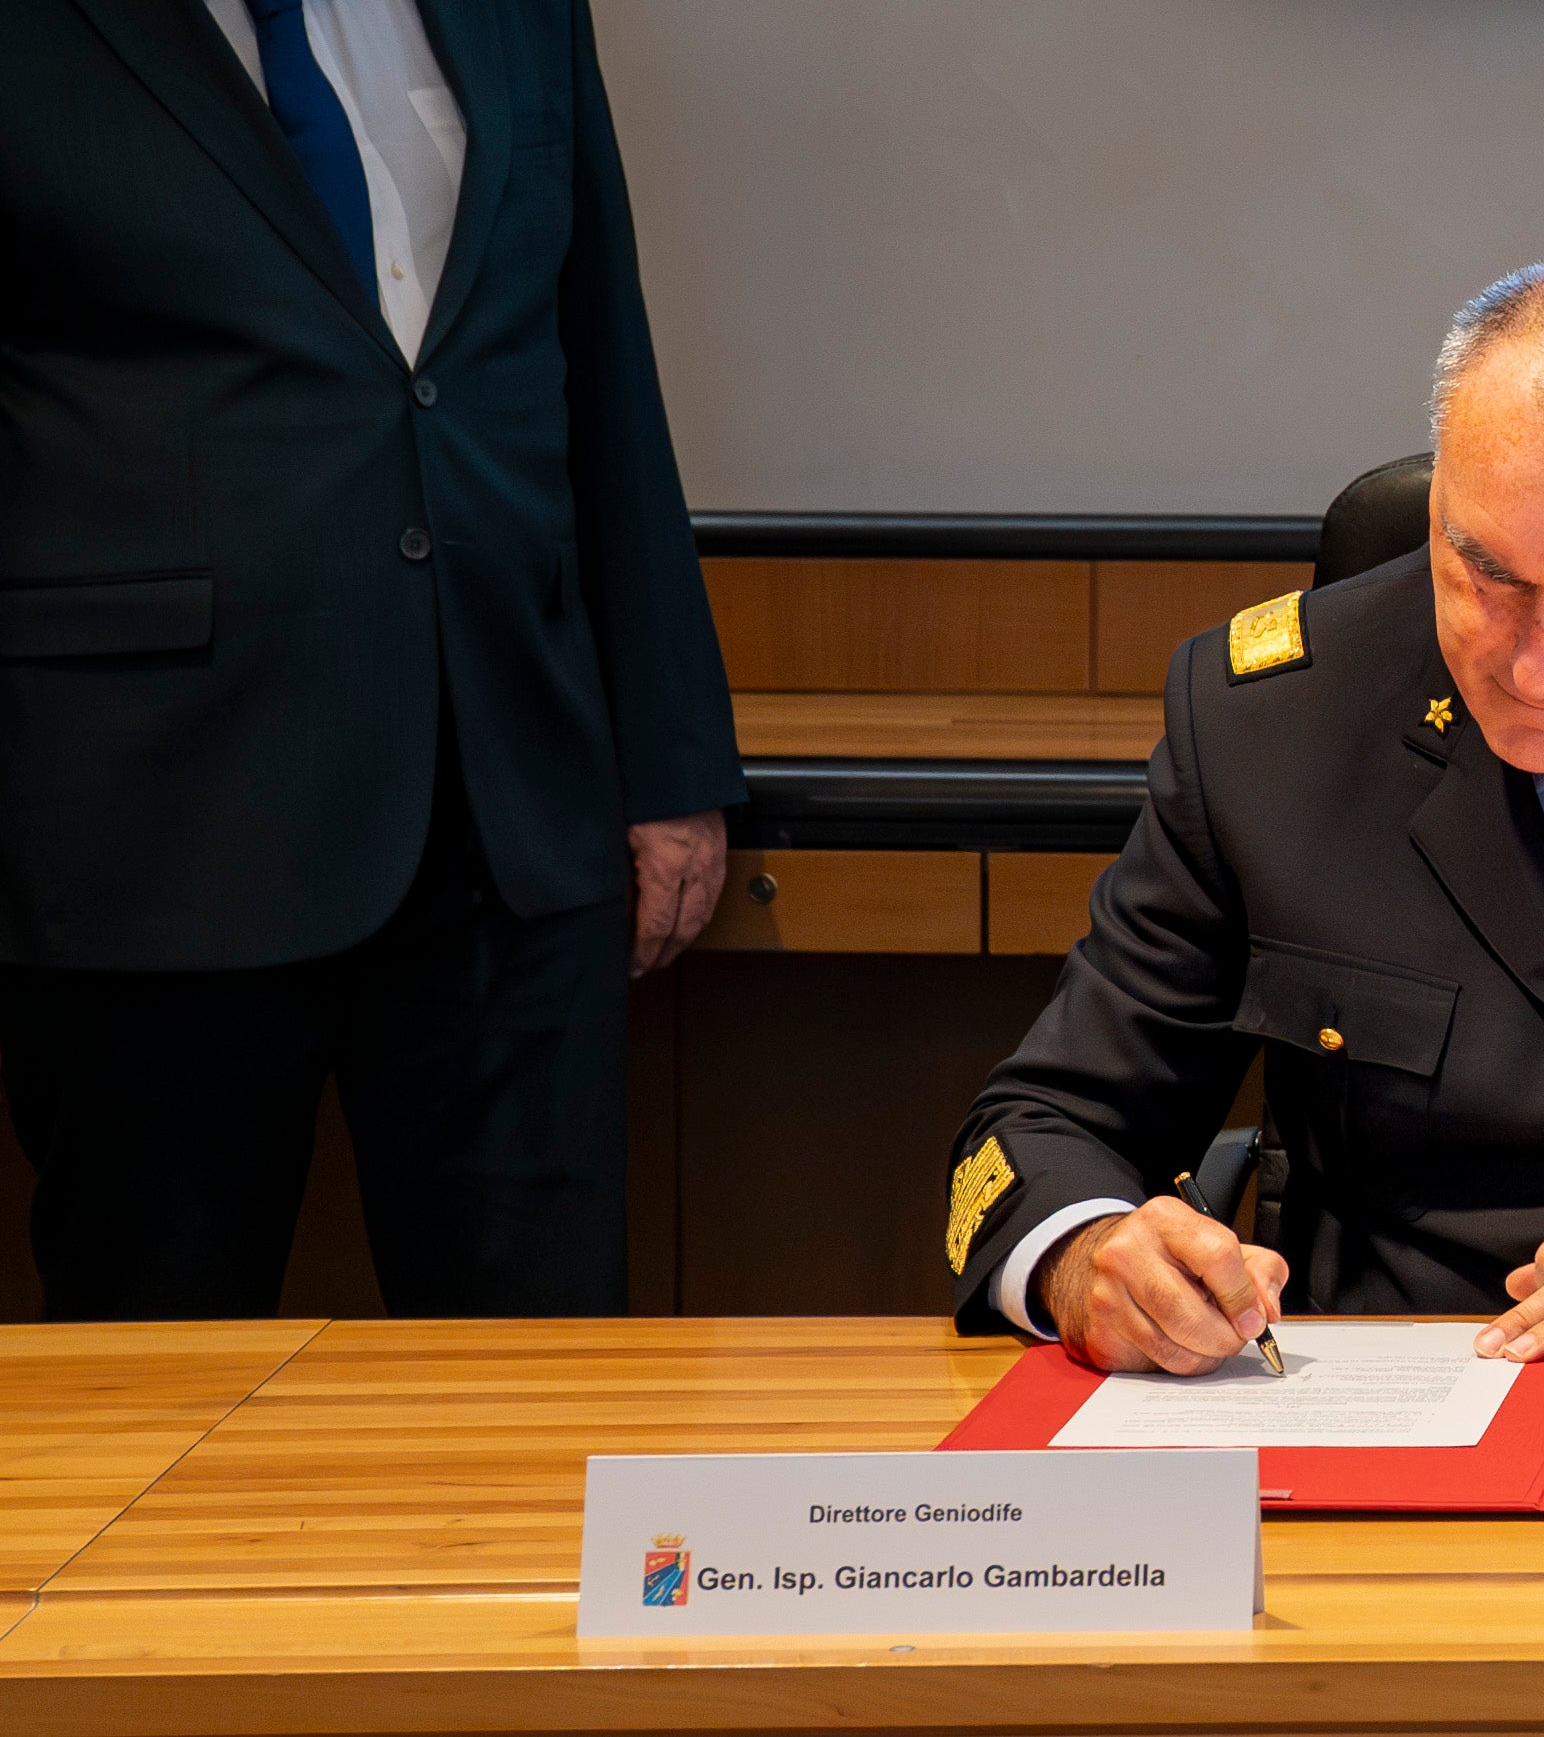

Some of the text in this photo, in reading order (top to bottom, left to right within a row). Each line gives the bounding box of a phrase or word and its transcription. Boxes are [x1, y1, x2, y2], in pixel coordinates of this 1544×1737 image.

[808, 1502, 1023, 1524] Direttore Geniodife
[696, 1562, 1166, 1597] Gen. Isp. Giancarlo Gambardella
